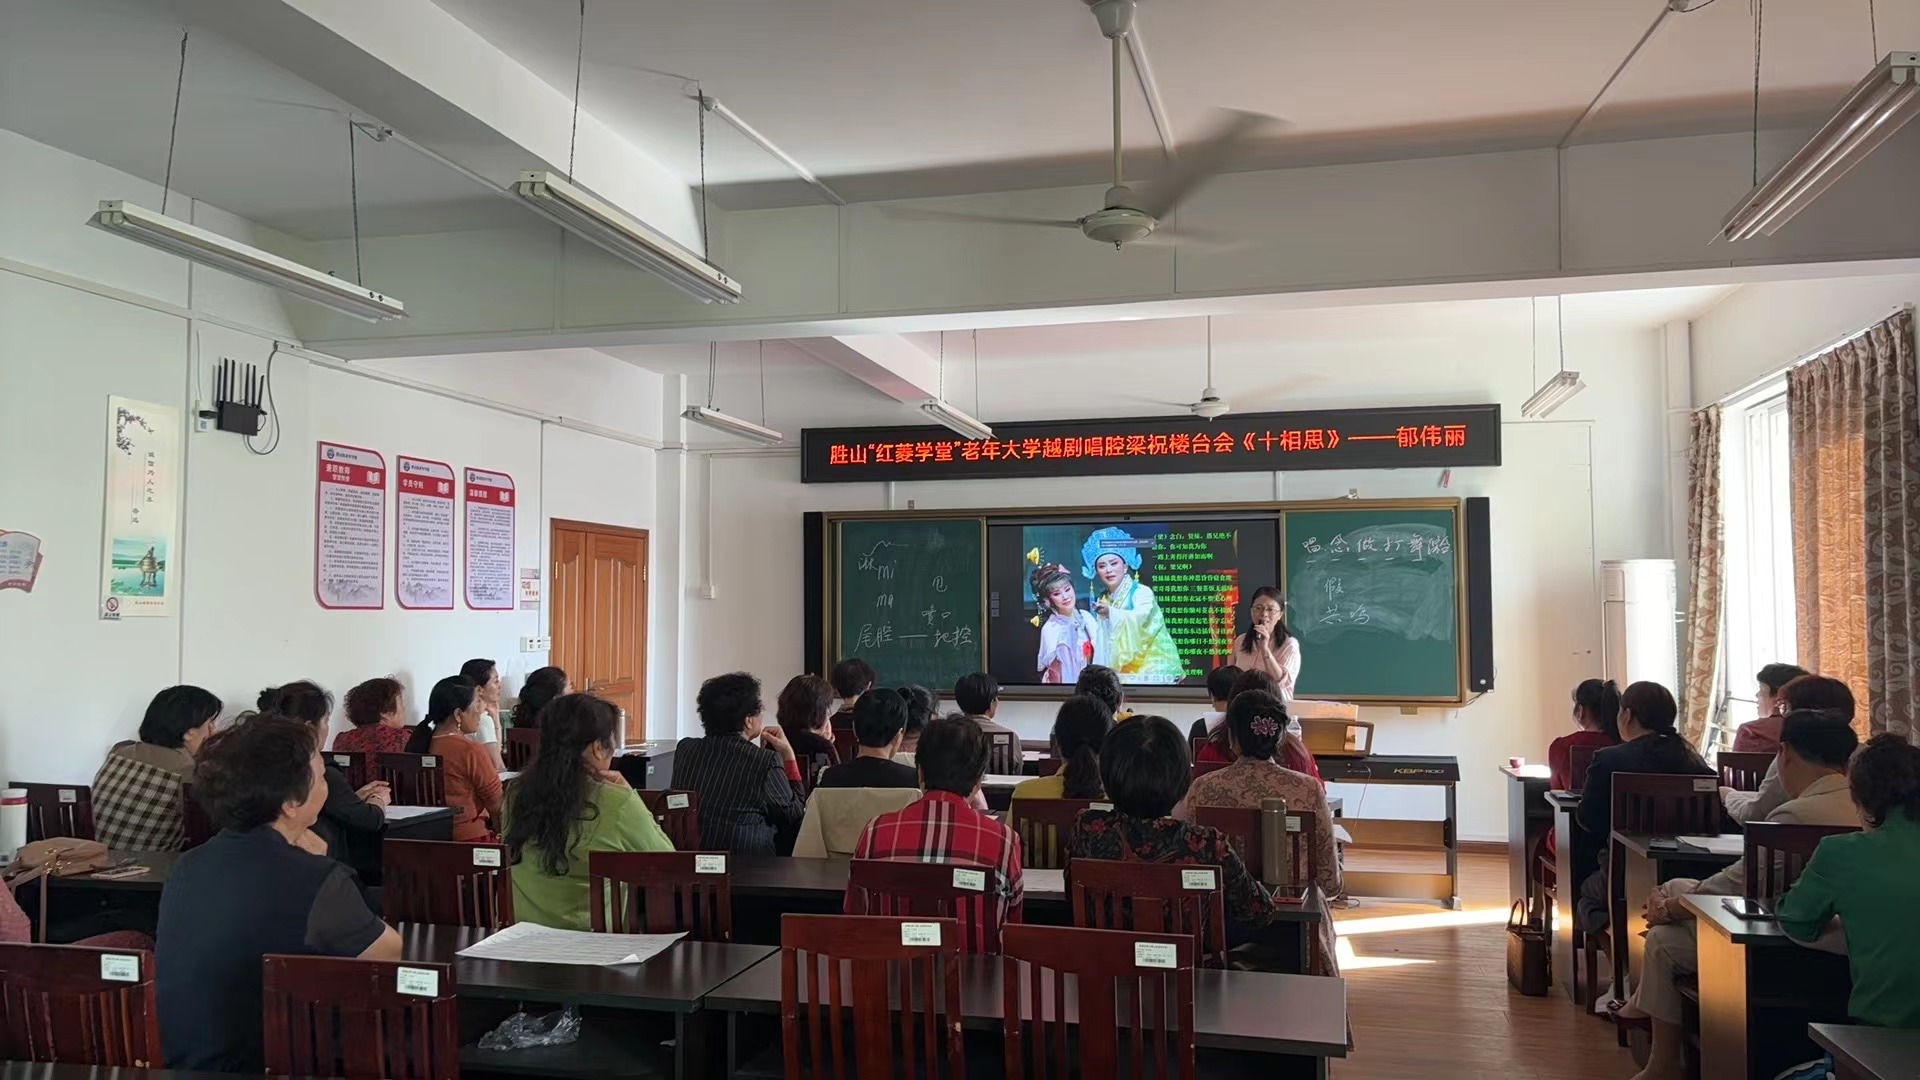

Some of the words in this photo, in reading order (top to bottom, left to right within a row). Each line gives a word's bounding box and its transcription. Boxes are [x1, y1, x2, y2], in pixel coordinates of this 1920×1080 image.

[829, 424, 1467, 465] 胜山“红菱学堂”老年大学越剧唱腔梁祝楼台会《十相思》——郁伟丽
[402, 478, 424, 490] 学员守则
